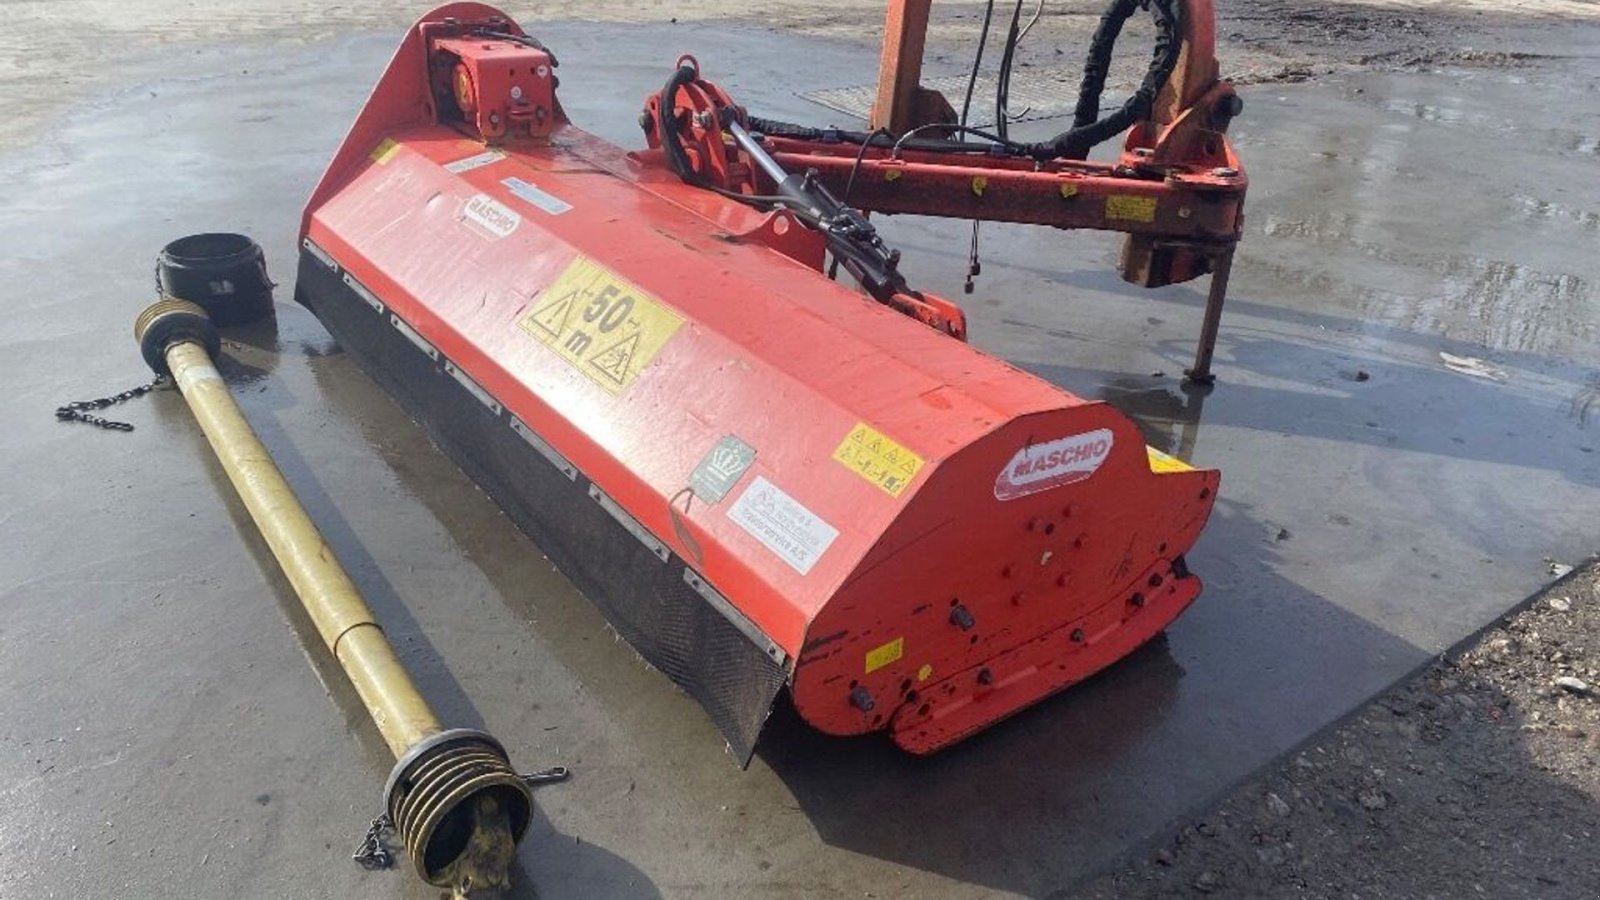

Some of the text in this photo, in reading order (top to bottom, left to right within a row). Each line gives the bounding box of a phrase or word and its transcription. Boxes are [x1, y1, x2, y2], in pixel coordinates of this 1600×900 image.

[469, 197, 515, 232] MASCHIO
[583, 284, 635, 334] 50
[564, 330, 593, 357] m
[1012, 438, 1108, 479] MASCHIO
